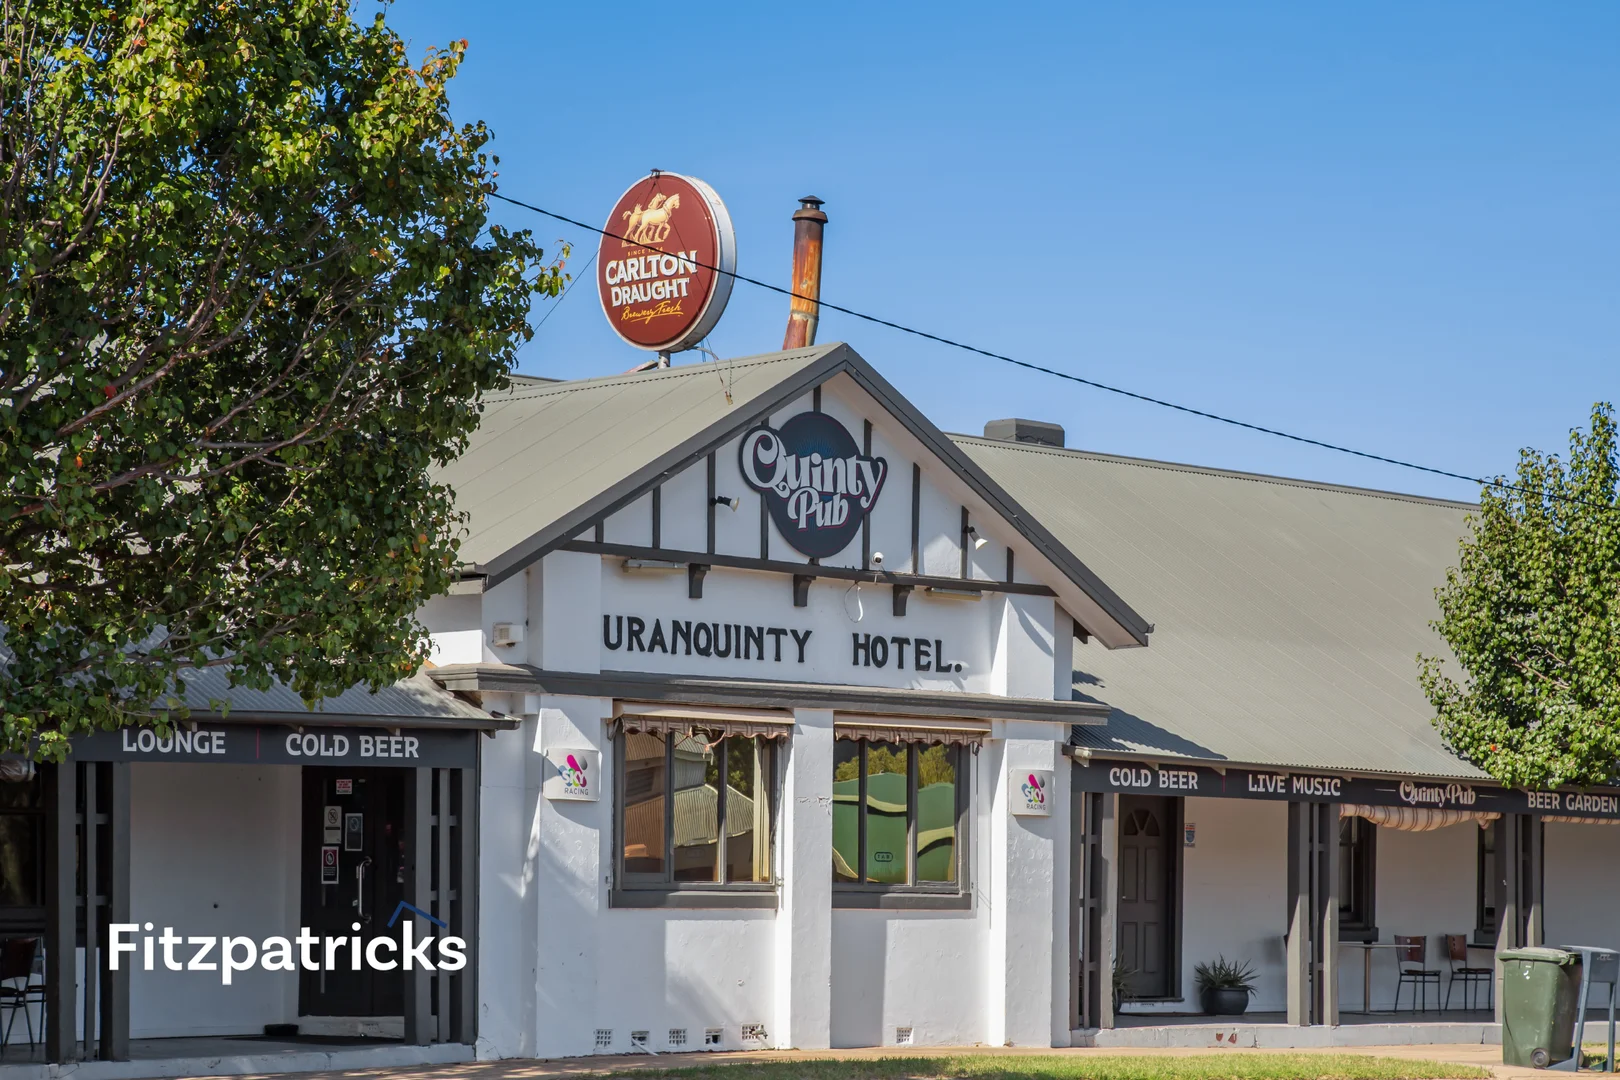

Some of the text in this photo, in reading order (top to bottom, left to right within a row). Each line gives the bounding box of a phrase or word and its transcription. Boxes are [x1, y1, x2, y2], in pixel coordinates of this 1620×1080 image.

[627, 246, 664, 257] SINCE 14
[605, 250, 698, 286] CARLTON
[611, 278, 690, 307] DRAUGHT
[621, 299, 683, 324] Brewery Fresh
[742, 429, 884, 509] Quinty
[787, 487, 849, 529] Pub
[603, 614, 963, 673] URANQUINTY HOTEL.
[122, 728, 226, 754] LOUNGE
[285, 733, 419, 758] COLD BEER
[1109, 767, 1199, 790] COLD BEER
[1248, 774, 1341, 797] LIVE MUSIC
[564, 788, 589, 796] RACING
[1400, 780, 1477, 807] Quinty Pub
[1527, 791, 1619, 813] BEER GARDEN
[1026, 803, 1047, 811] RACING
